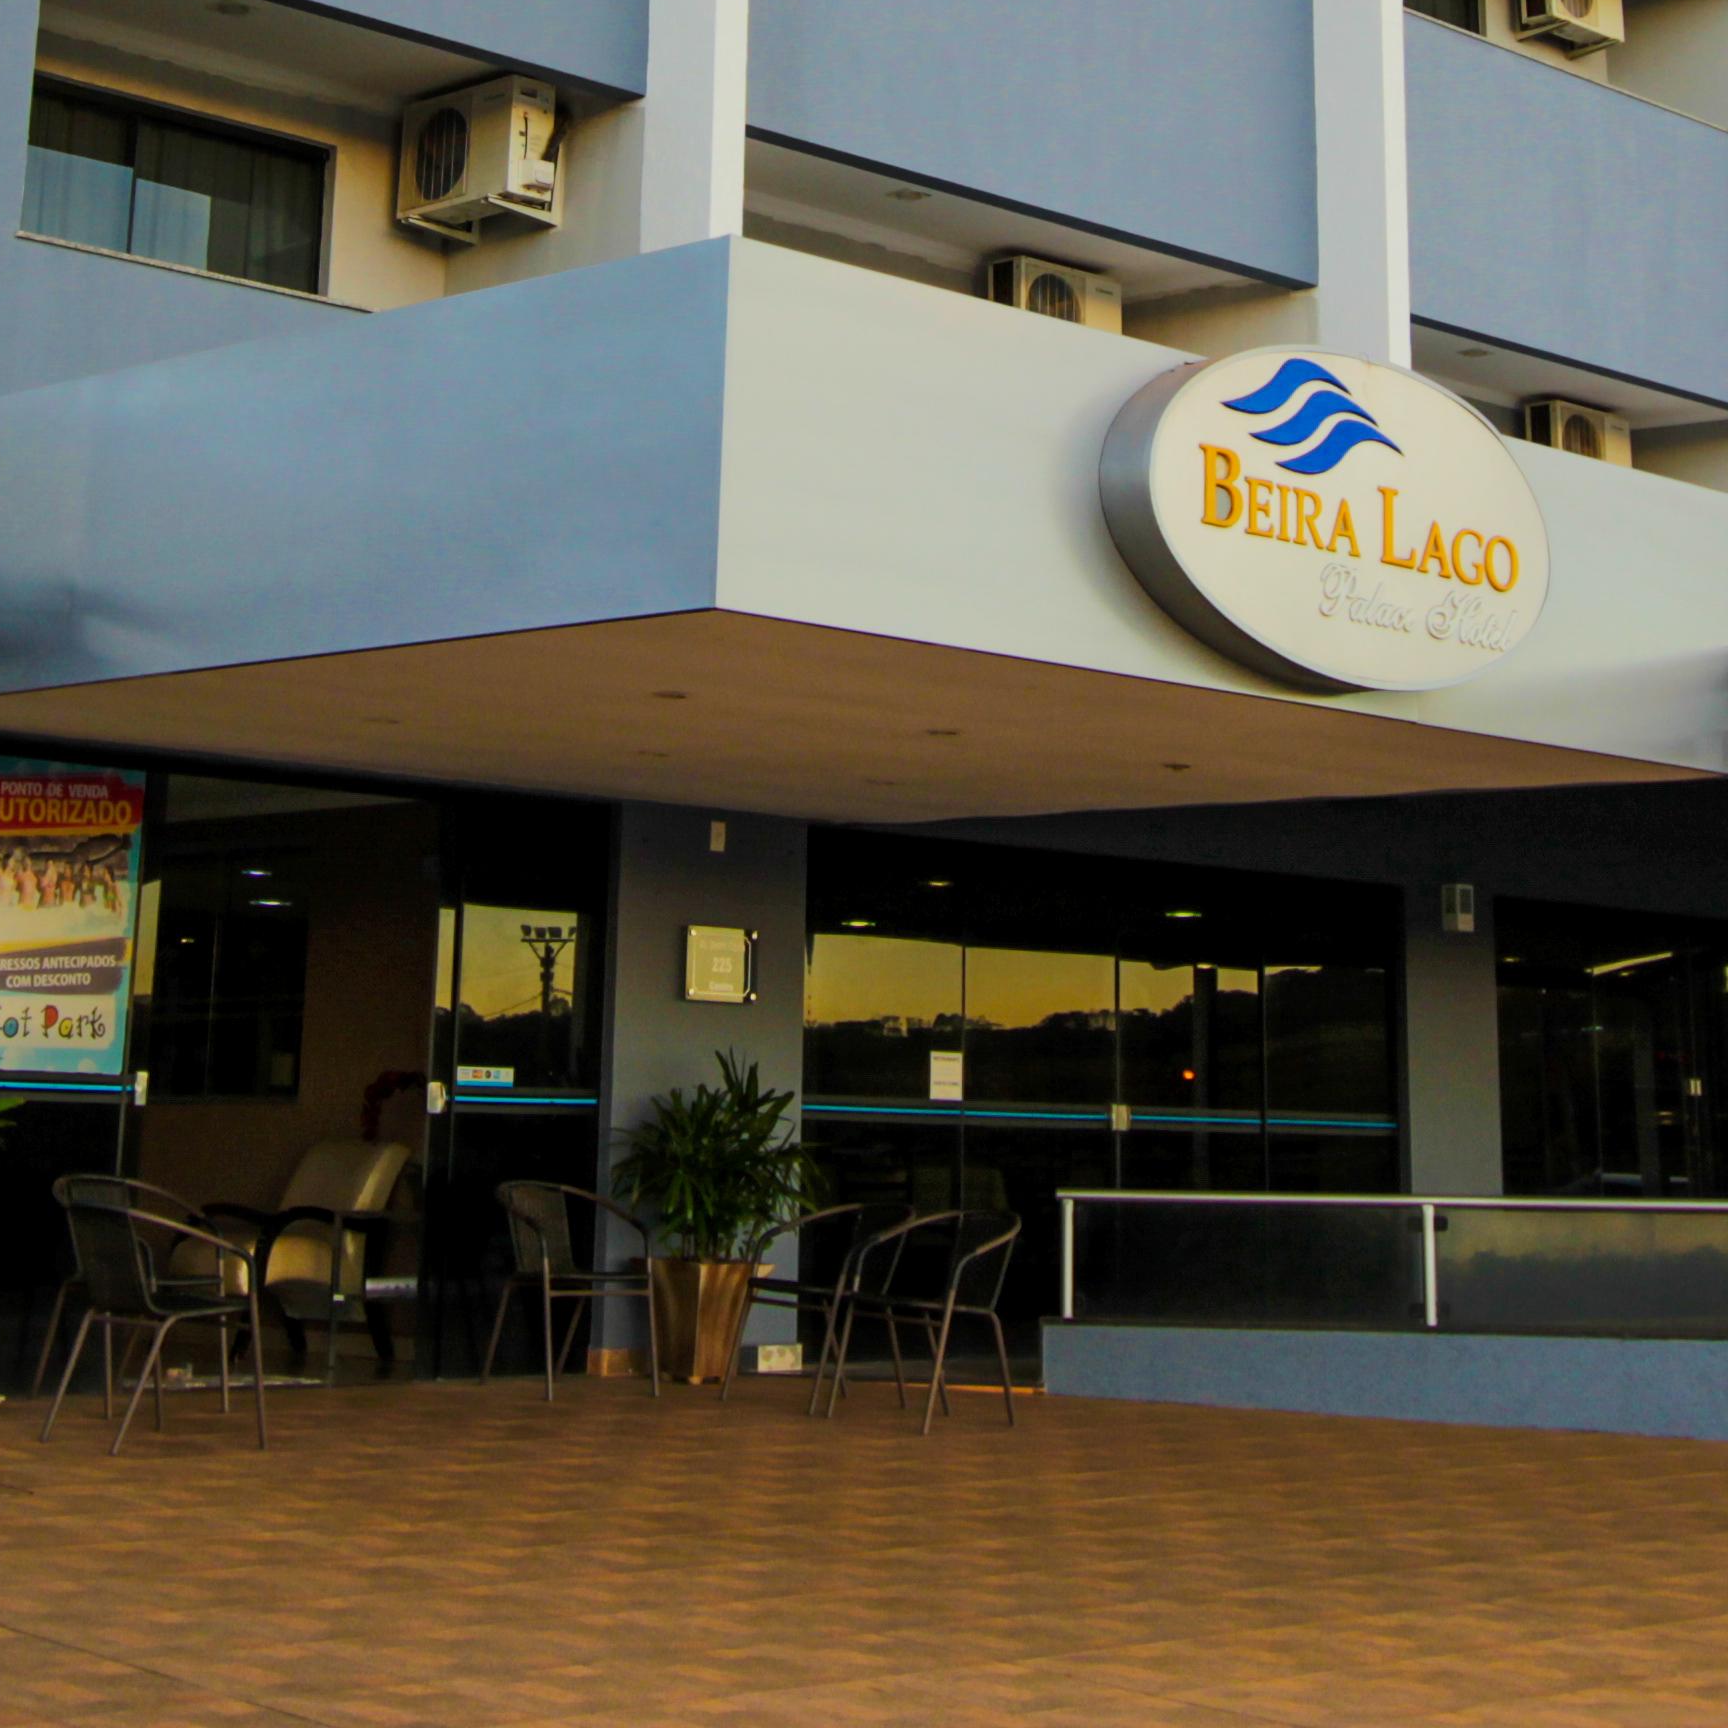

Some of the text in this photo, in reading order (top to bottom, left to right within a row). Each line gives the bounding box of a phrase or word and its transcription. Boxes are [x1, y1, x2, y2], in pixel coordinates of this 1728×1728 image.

[1198, 443, 1520, 594] BEIRA LAGO
[0, 781, 109, 799] PONTO DE VENDA
[41, 954, 117, 970] ANTECIPADOS
[5, 972, 92, 989] COM DESCONTO
[39, 1003, 107, 1040] Park
